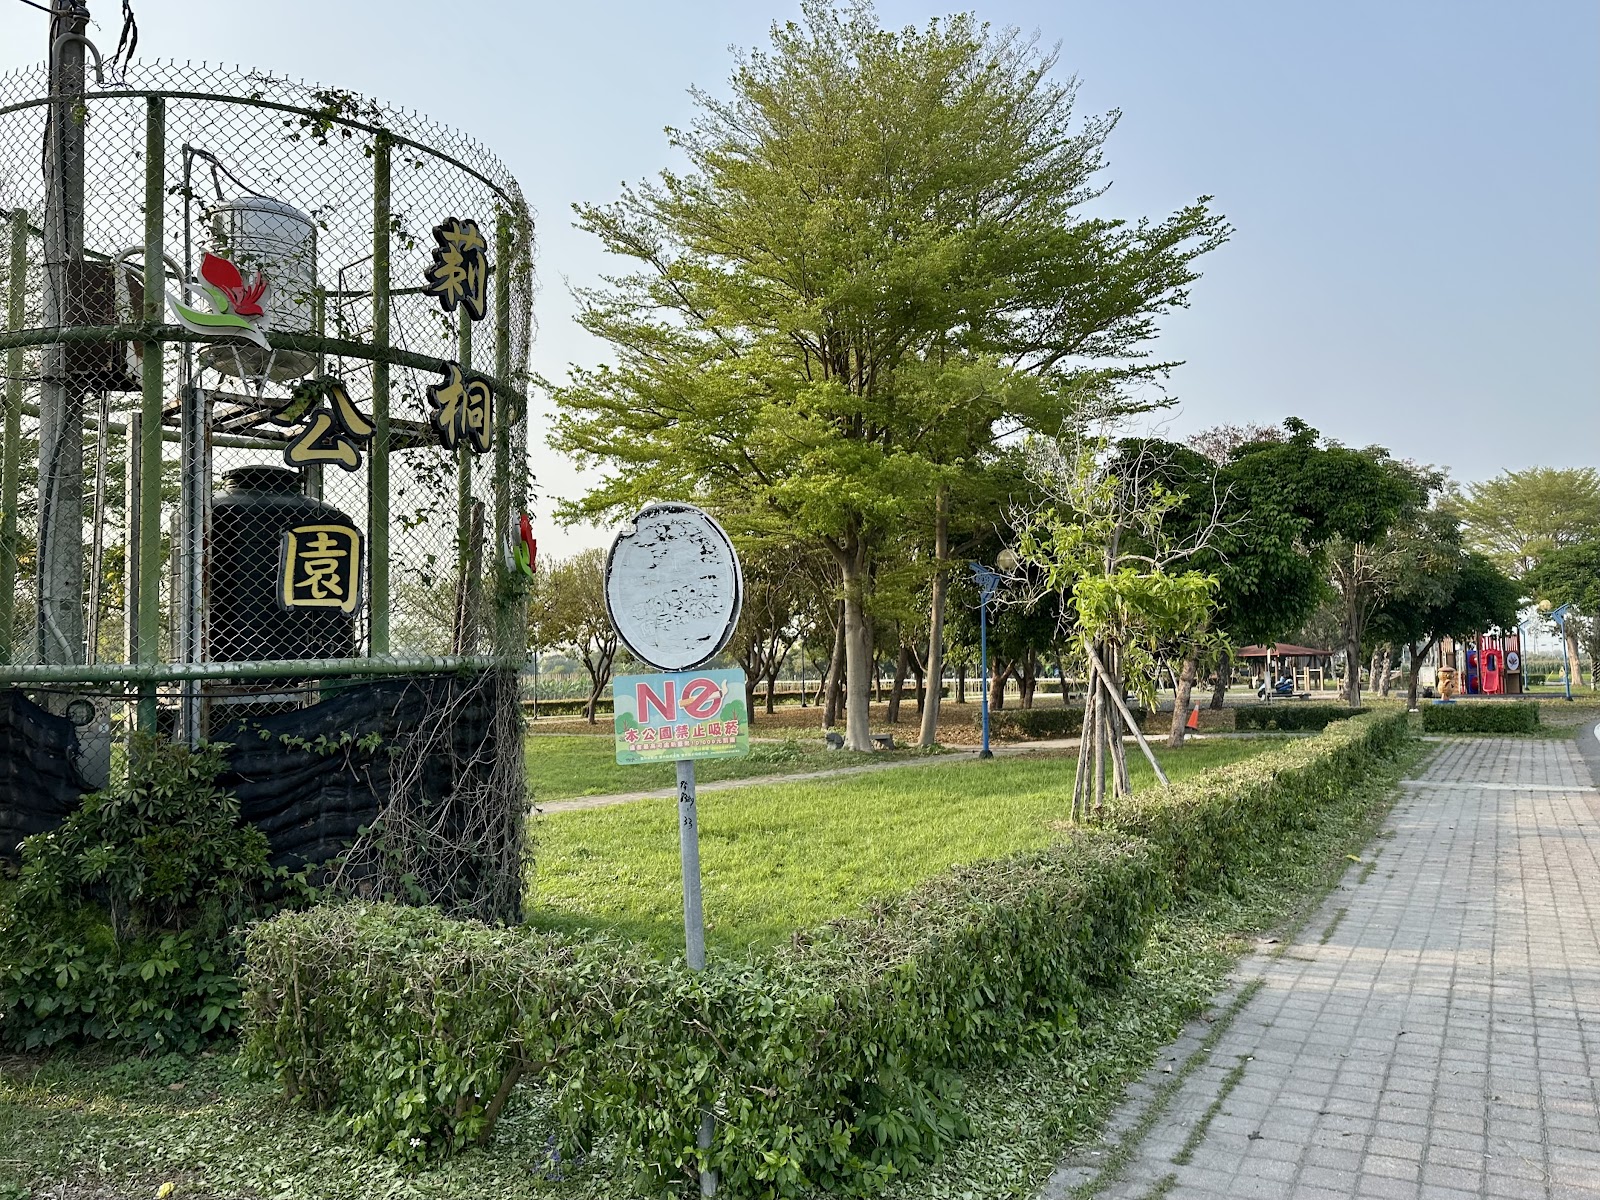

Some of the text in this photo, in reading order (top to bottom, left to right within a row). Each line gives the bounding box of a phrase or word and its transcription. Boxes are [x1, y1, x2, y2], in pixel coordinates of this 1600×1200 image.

[273, 380, 376, 616] 公園
[636, 678, 723, 724] NO
[624, 720, 740, 743] 本公園禁止吸菸
